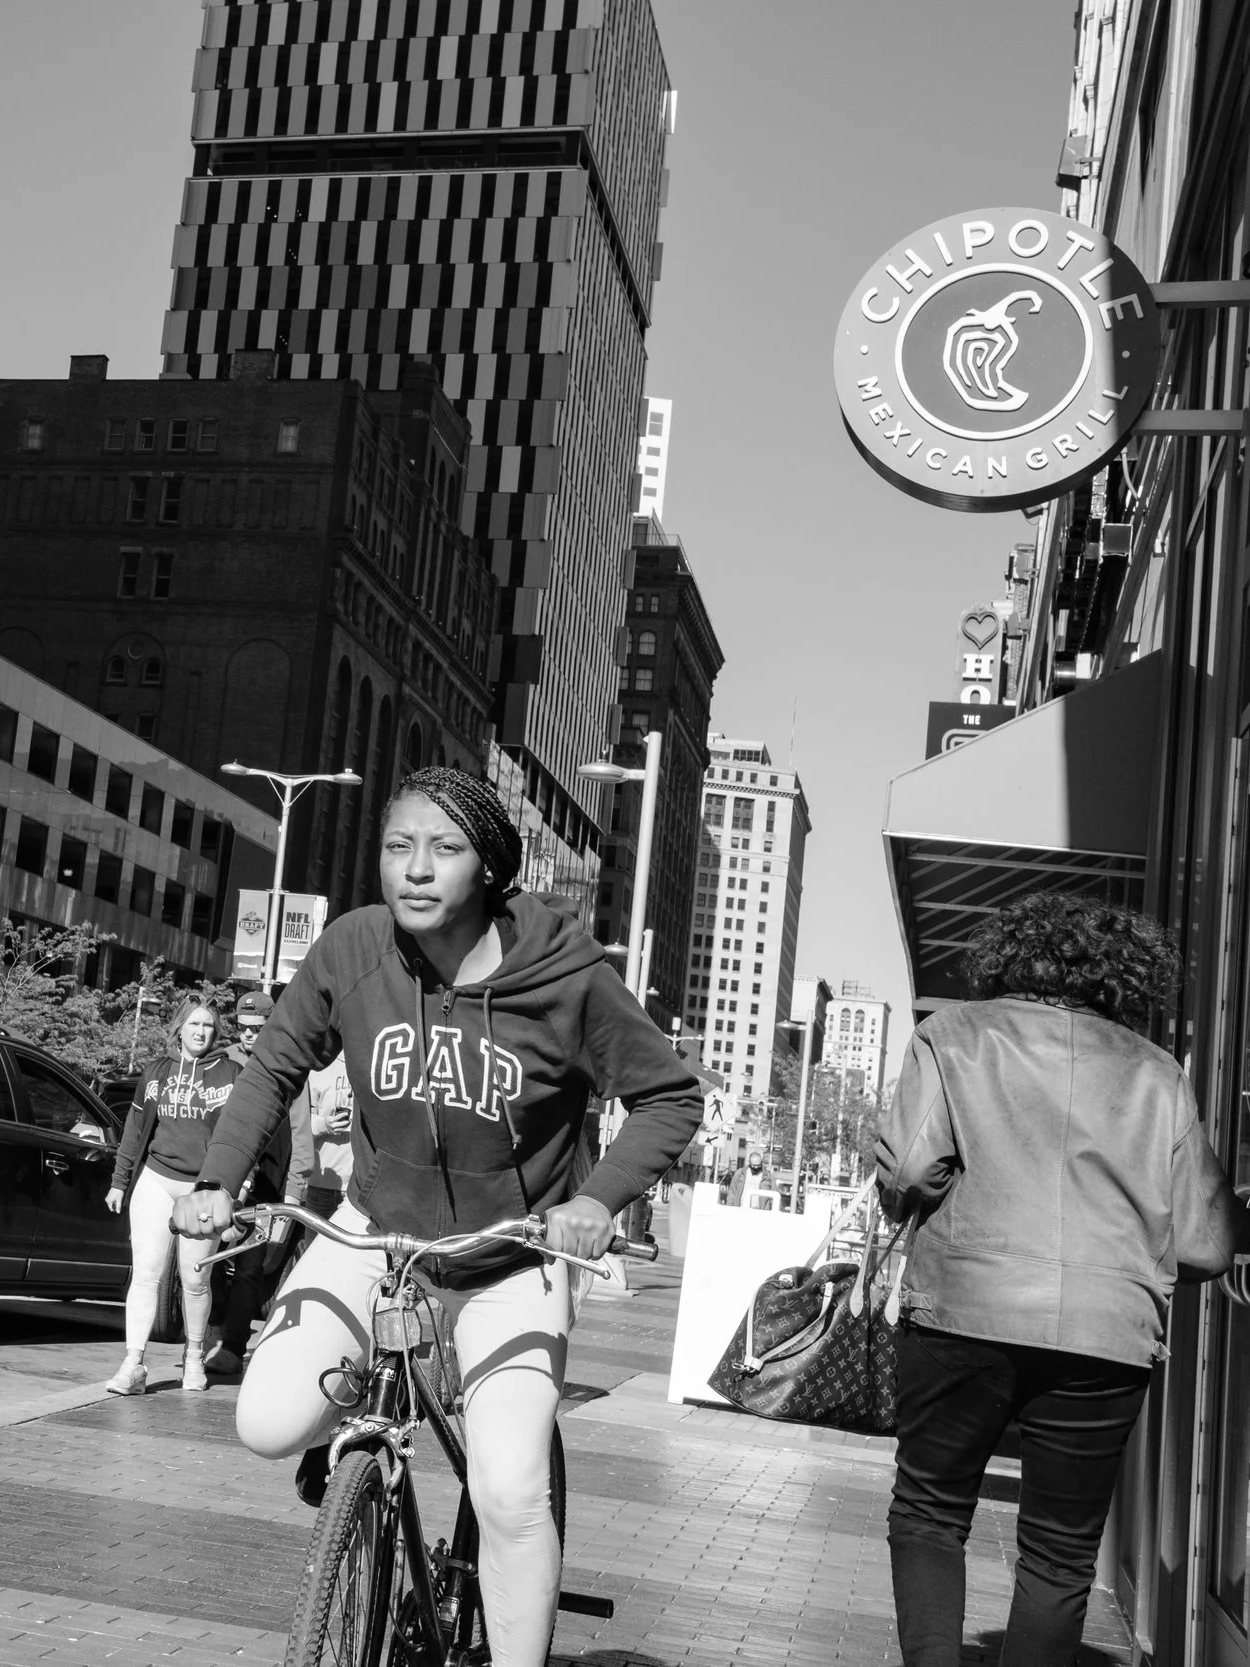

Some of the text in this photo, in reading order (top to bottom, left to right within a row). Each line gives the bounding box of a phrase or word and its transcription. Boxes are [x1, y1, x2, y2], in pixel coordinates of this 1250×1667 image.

[861, 219, 1144, 330] CHIPOTLE
[858, 376, 1128, 478] MEXICAN GRILL
[963, 715, 981, 725] THE
[286, 912, 310, 924] NFL
[285, 923, 310, 940] DRAFT
[371, 1022, 523, 1122] GAP
[157, 1104, 207, 1119] THE CITY
